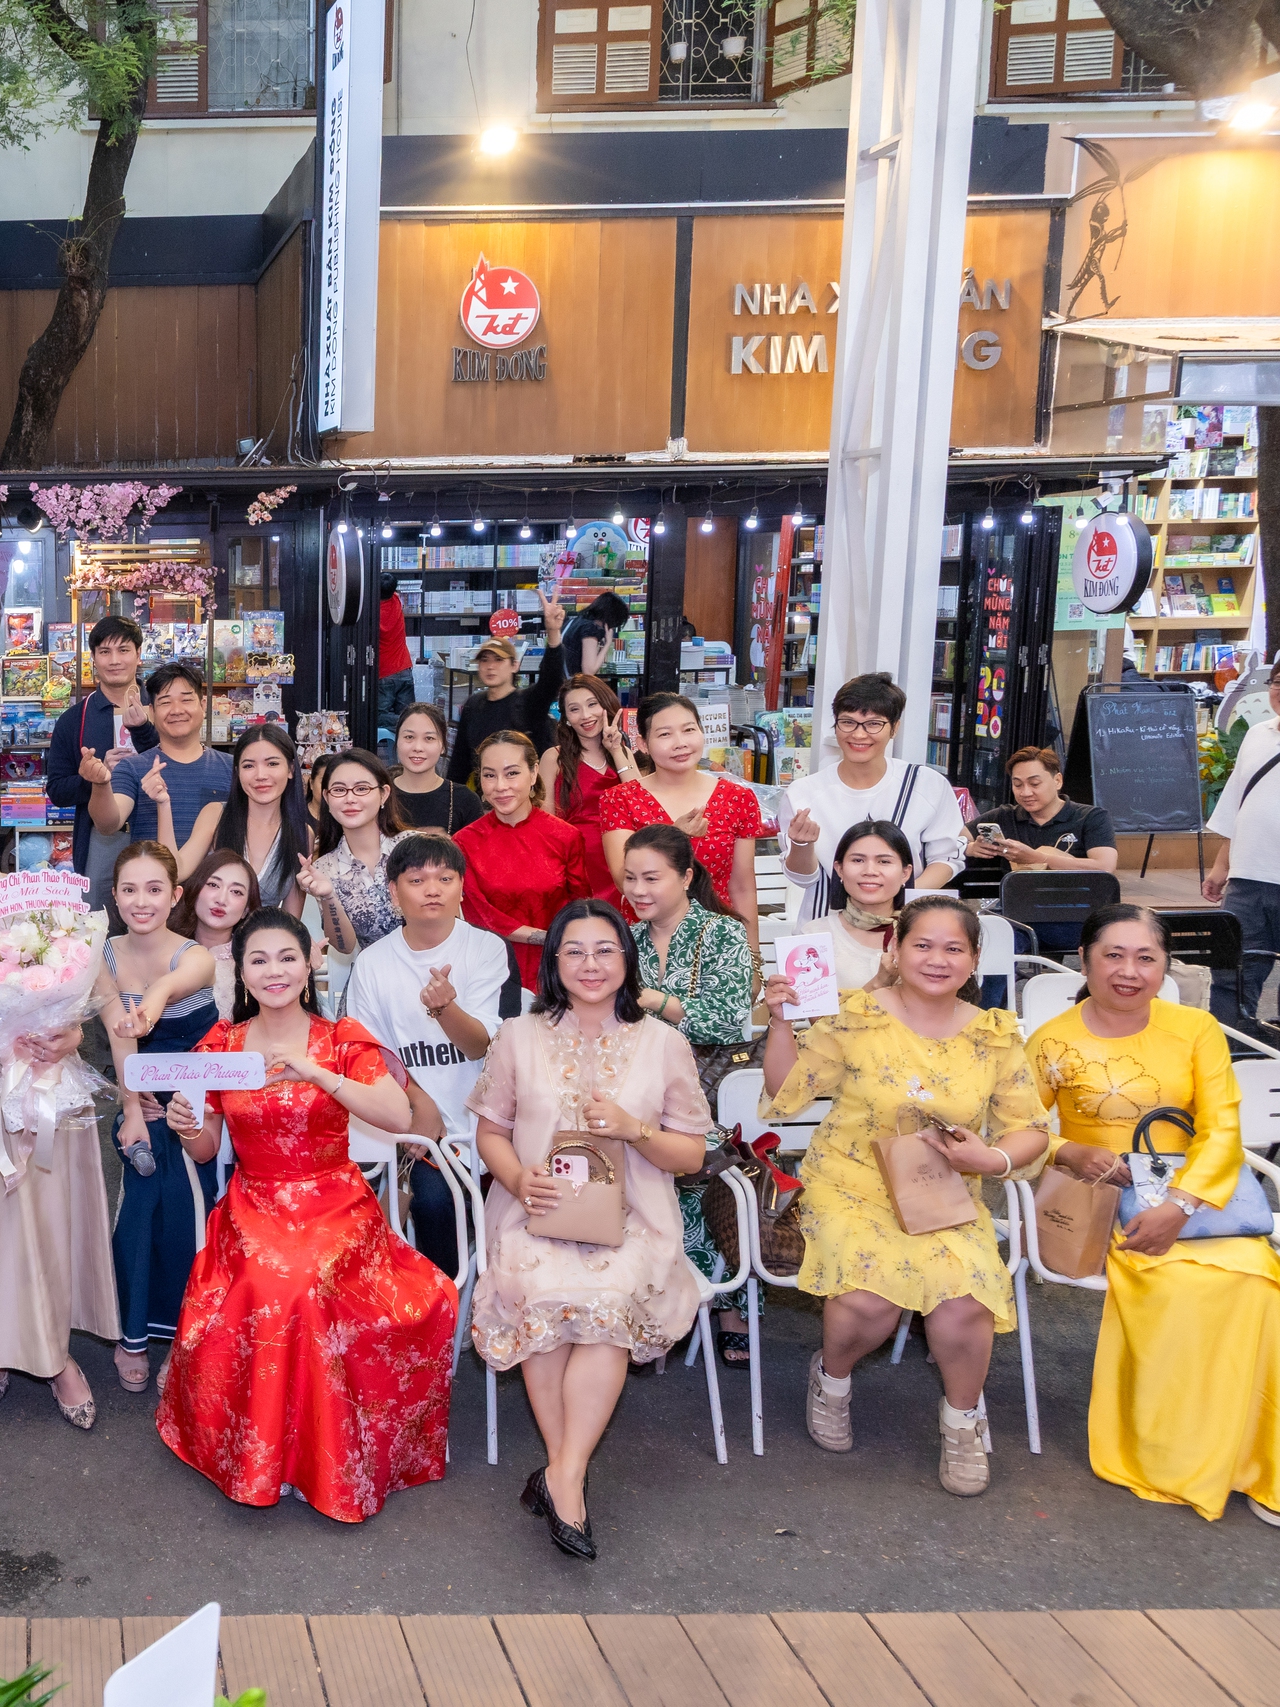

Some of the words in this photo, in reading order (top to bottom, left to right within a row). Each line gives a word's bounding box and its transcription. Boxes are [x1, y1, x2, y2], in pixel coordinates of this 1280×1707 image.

[335, 87, 345, 164] HOUSE
[333, 170, 341, 294] PUBLISHING
[958, 266, 1011, 311] ẢN
[331, 300, 339, 372] DONG
[451, 346, 492, 382] KIM
[495, 343, 548, 382] ĐỒNG
[730, 334, 829, 375] KIM
[329, 378, 337, 415] KIM
[754, 572, 777, 594] CHÚ
[987, 573, 1013, 593] CHÚC
[1083, 578, 1099, 598] KIM
[751, 596, 774, 619] MỪN
[983, 593, 1012, 612] MỪNG
[491, 617, 518, 629] -10%
[988, 612, 1011, 631] NĂM
[1102, 700, 1129, 716] Phát
[704, 723, 727, 734] TLAS
[8, 873, 21, 887] Chị
[21, 872, 40, 884] Phan
[41, 871, 61, 883] Thảo
[61, 871, 89, 892] Phương
[10, 885, 40, 898] Mắt
[41, 885, 71, 897] Sách
[25, 899, 51, 910] THƯƠNG
[398, 1040, 467, 1069] uthen
[140, 1064, 171, 1082] Phan
[169, 1063, 201, 1081] Thảo
[202, 1061, 250, 1085] Phương
